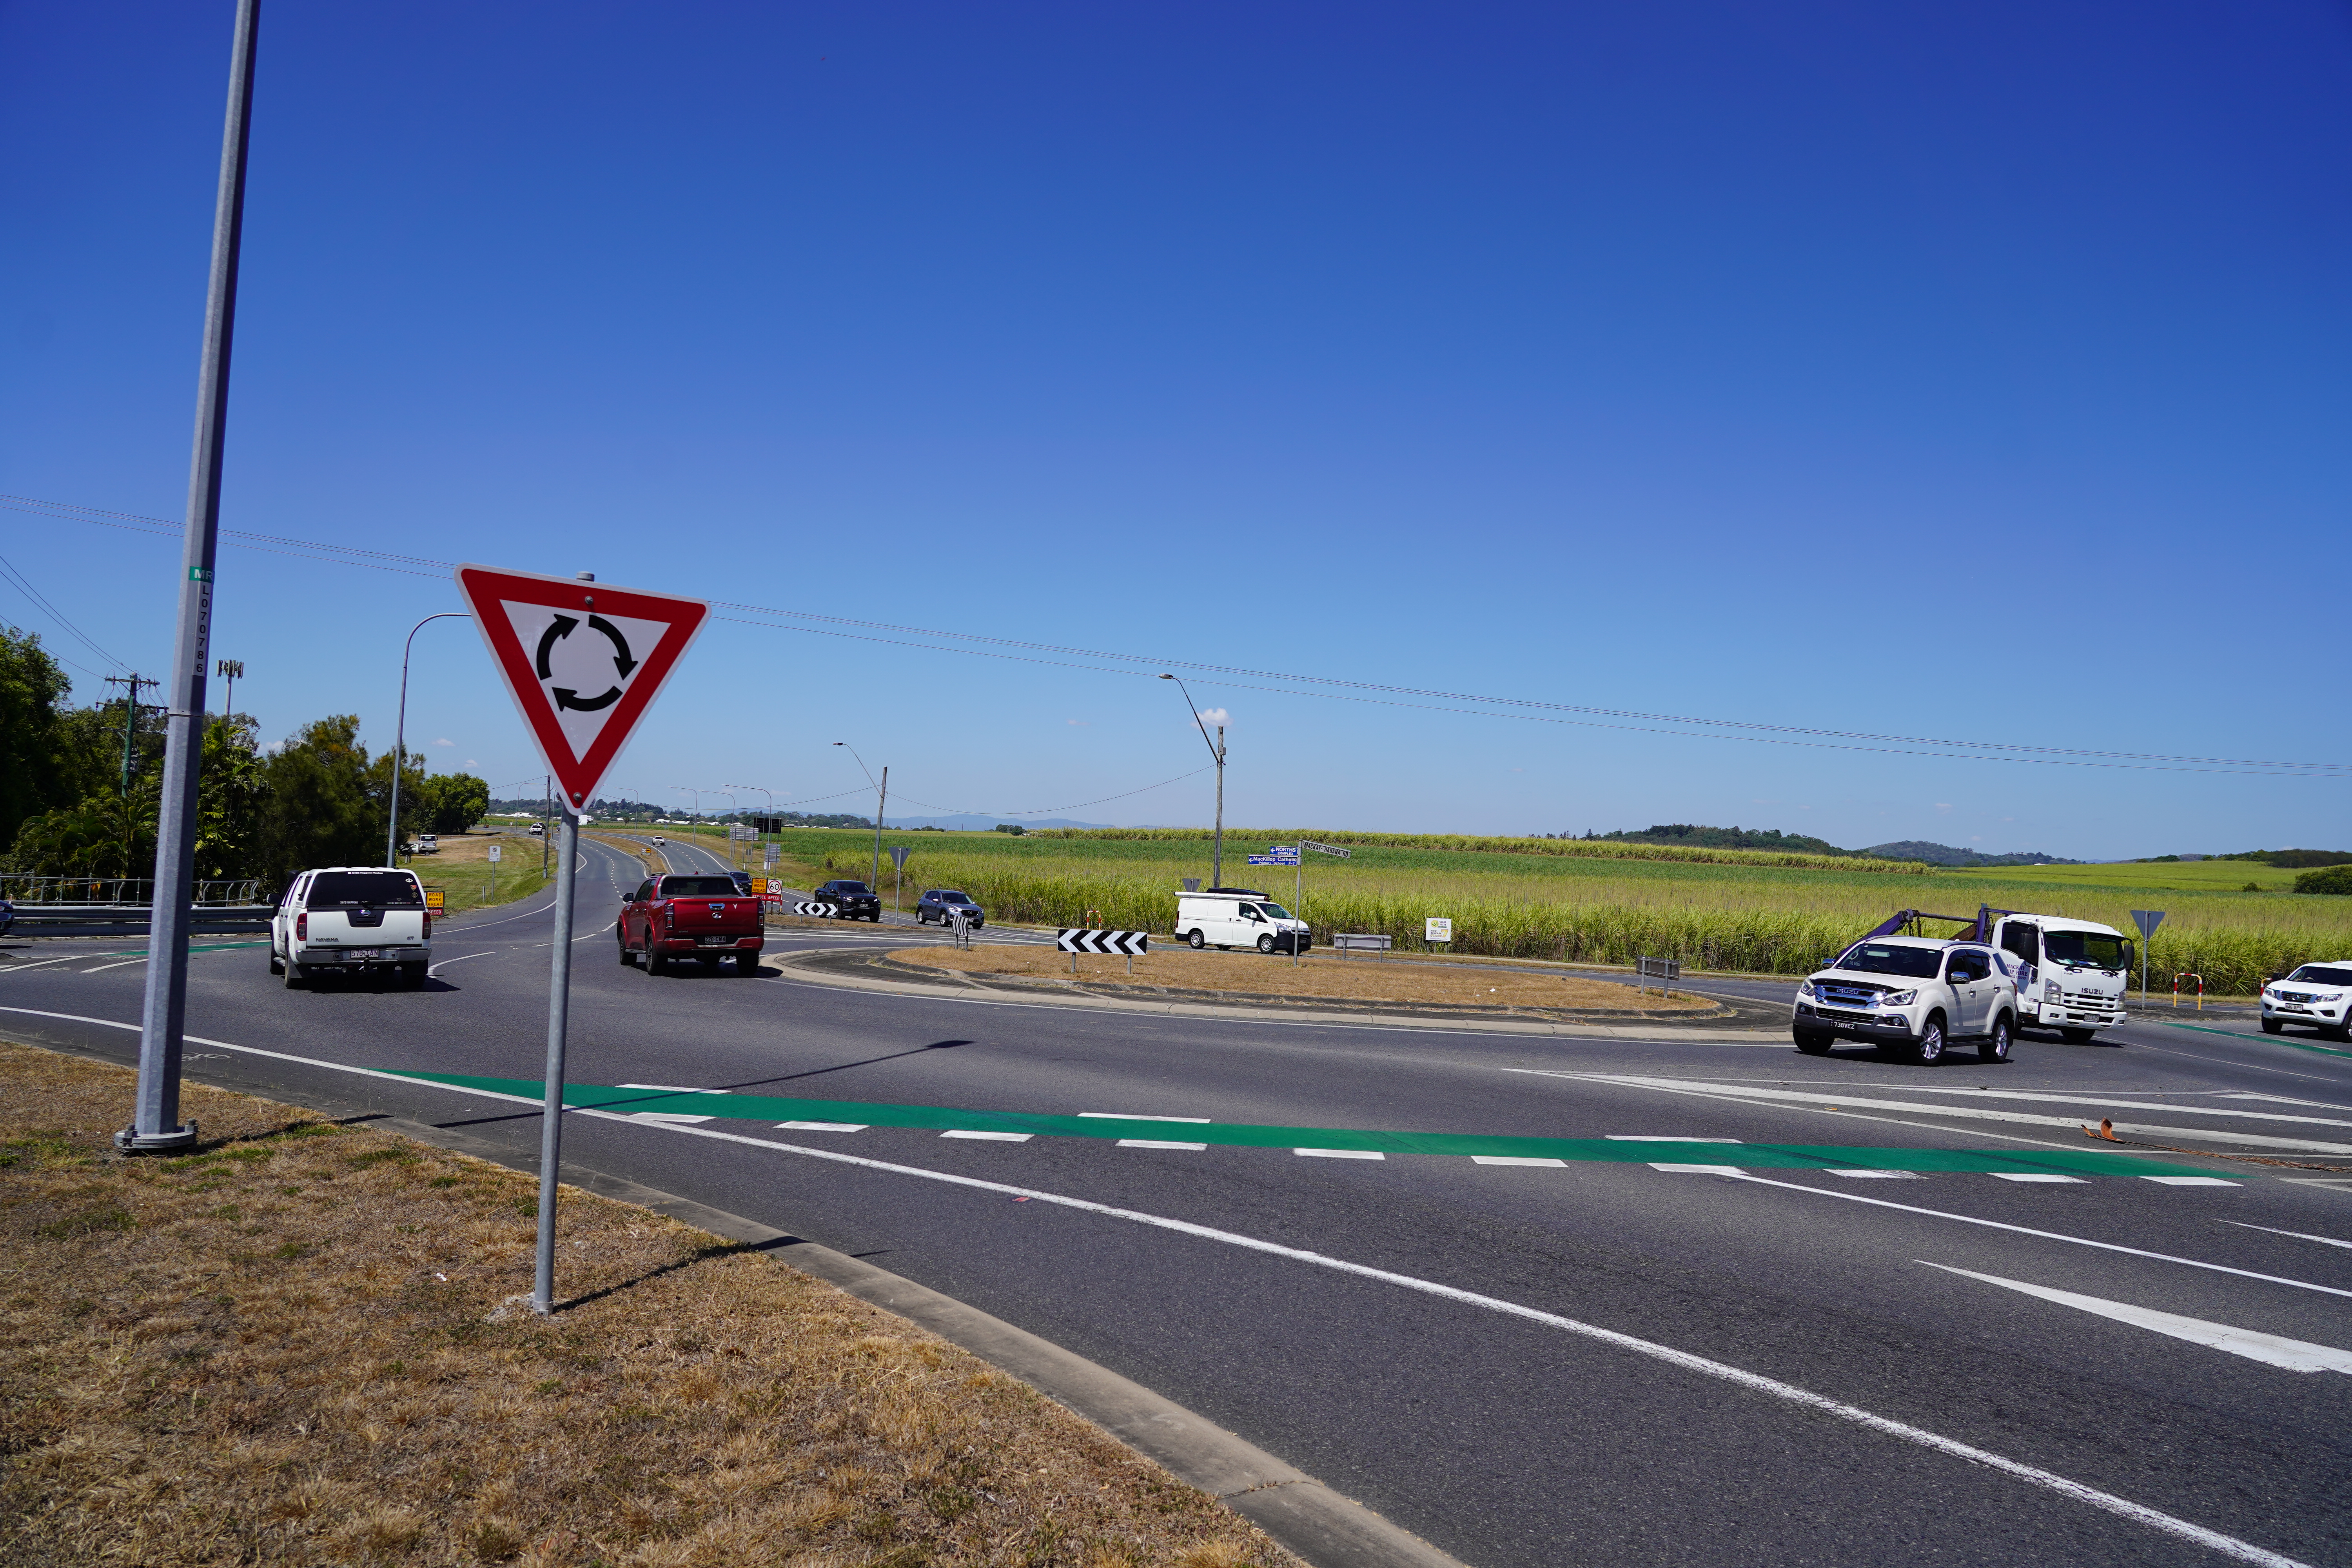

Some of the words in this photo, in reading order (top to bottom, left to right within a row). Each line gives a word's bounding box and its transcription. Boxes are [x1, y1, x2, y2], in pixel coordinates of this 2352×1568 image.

[194, 569, 212, 579] MR
[196, 585, 209, 673] L070786
[1304, 842, 1340, 855] MACKAY-HABANA
[1441, 929, 1449, 937] 7
